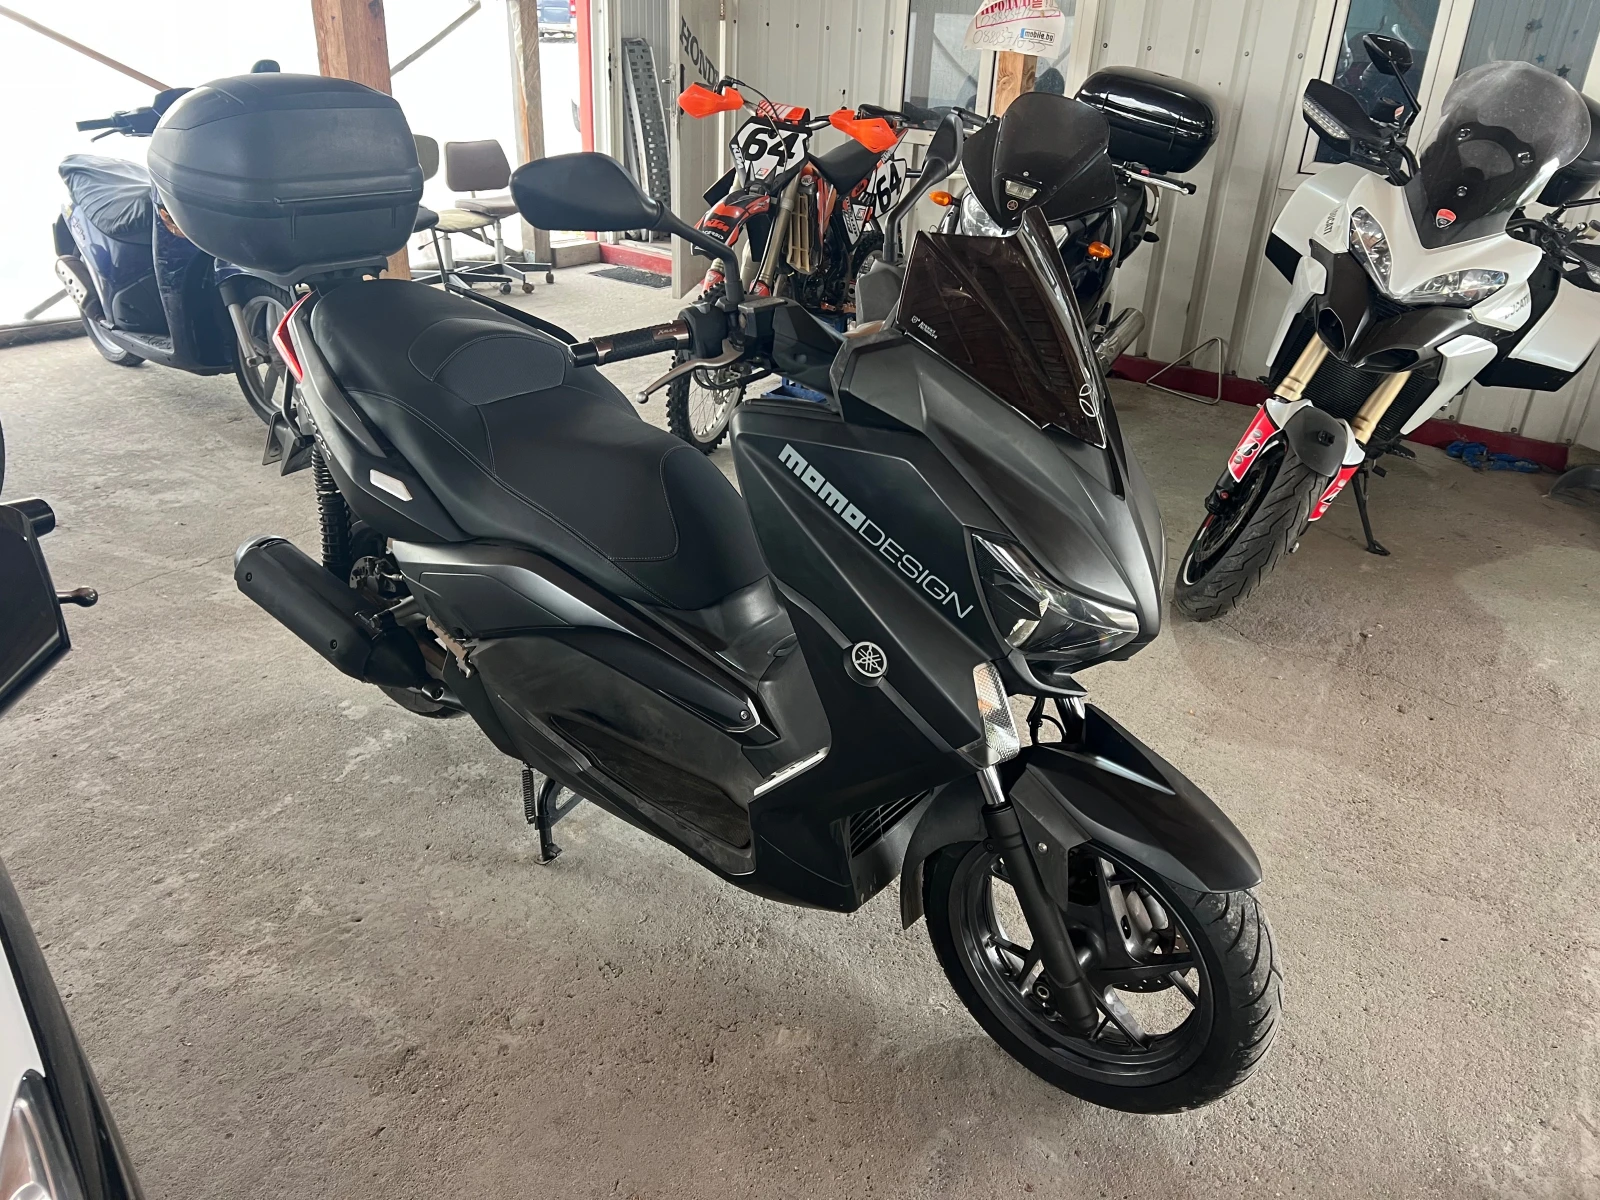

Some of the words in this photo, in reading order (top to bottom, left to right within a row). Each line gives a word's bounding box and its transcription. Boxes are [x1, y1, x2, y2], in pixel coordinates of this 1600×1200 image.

[1024, 30, 1054, 42] mobile.bg
[741, 127, 801, 168] 64
[877, 163, 902, 214] 64
[704, 218, 730, 232] KTM
